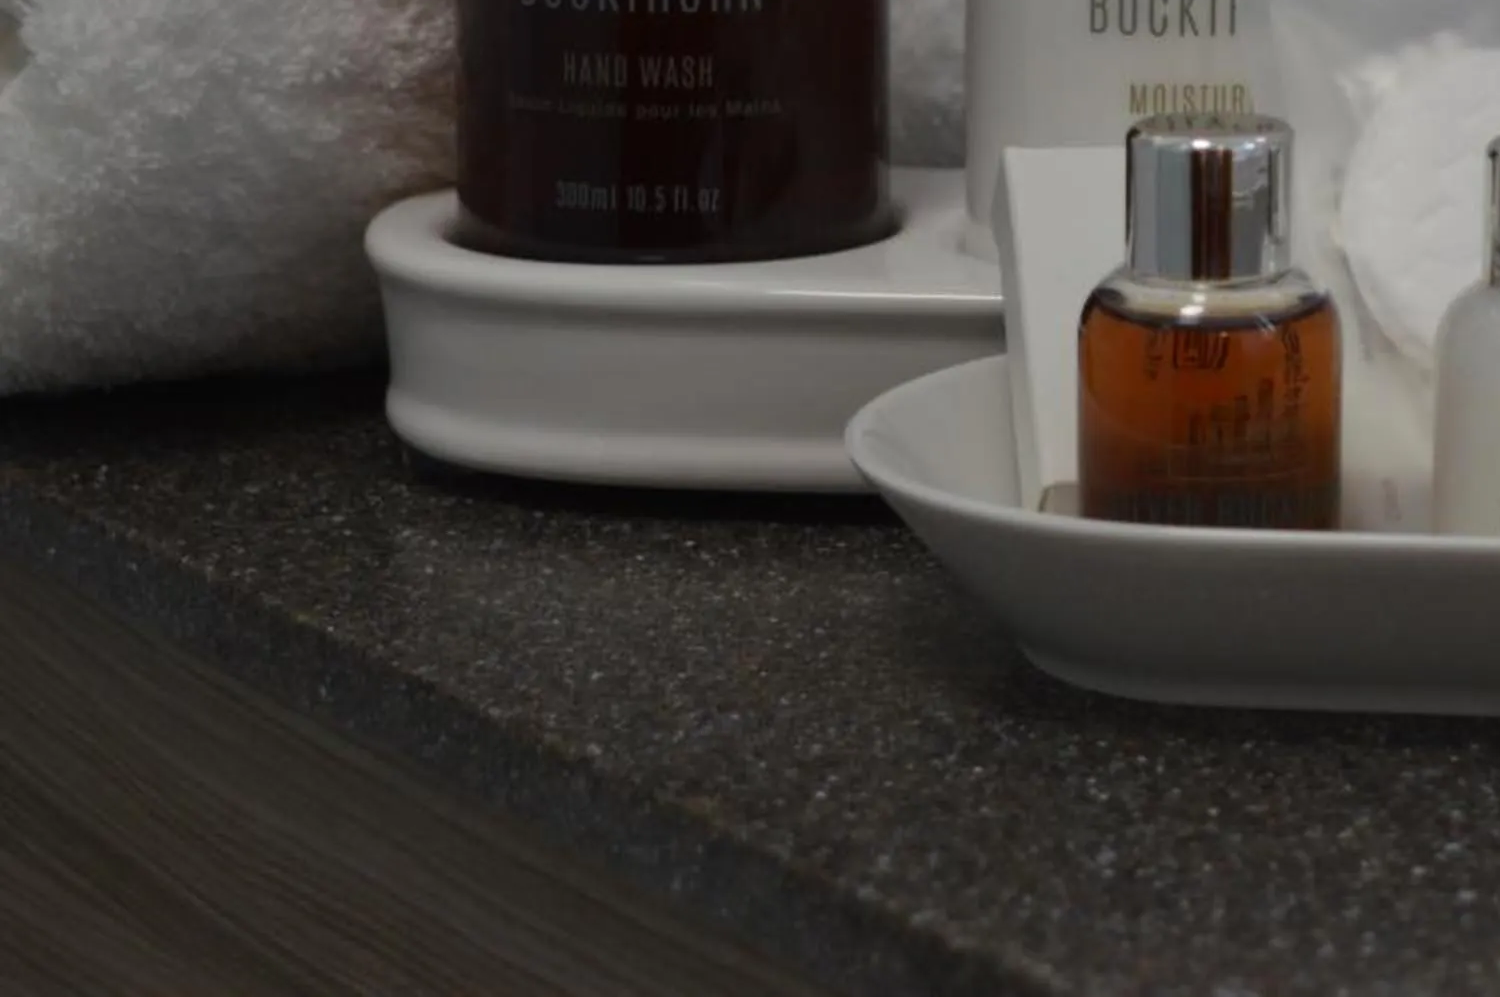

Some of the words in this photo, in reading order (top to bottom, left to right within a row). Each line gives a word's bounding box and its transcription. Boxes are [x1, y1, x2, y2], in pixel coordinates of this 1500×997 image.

[563, 51, 629, 87] HAND
[639, 54, 715, 90] WASH
[1128, 82, 1255, 115] MOISTUR
[554, 179, 618, 212] 300ml
[626, 183, 668, 214] 10.5
